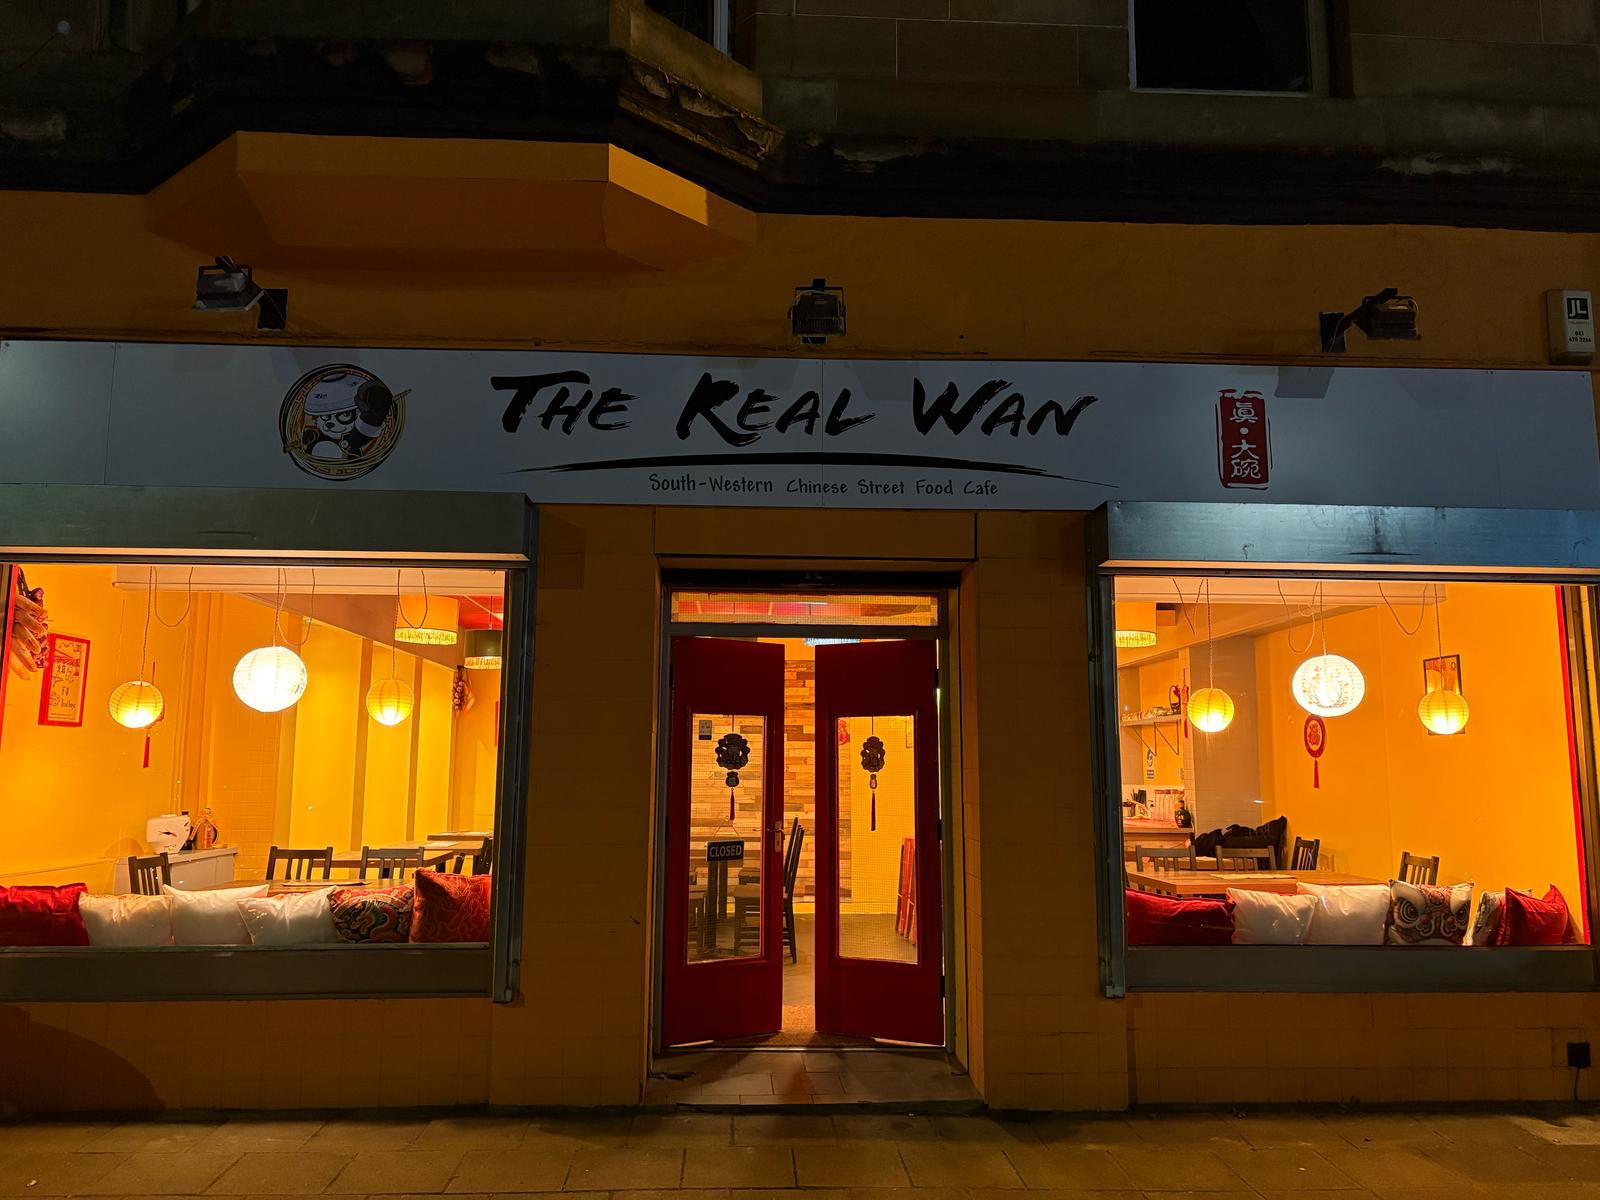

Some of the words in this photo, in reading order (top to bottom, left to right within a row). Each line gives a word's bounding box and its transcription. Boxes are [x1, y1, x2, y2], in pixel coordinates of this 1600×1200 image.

[490, 370, 640, 435] THE
[675, 372, 876, 447] REAL
[912, 377, 1099, 437] WAN
[649, 473, 773, 493] South-Western
[786, 478, 848, 494] Chinese
[857, 479, 905, 495] Street
[916, 479, 953, 495] Food
[963, 480, 999, 495] Cafe
[709, 844, 742, 858] CLOSED
